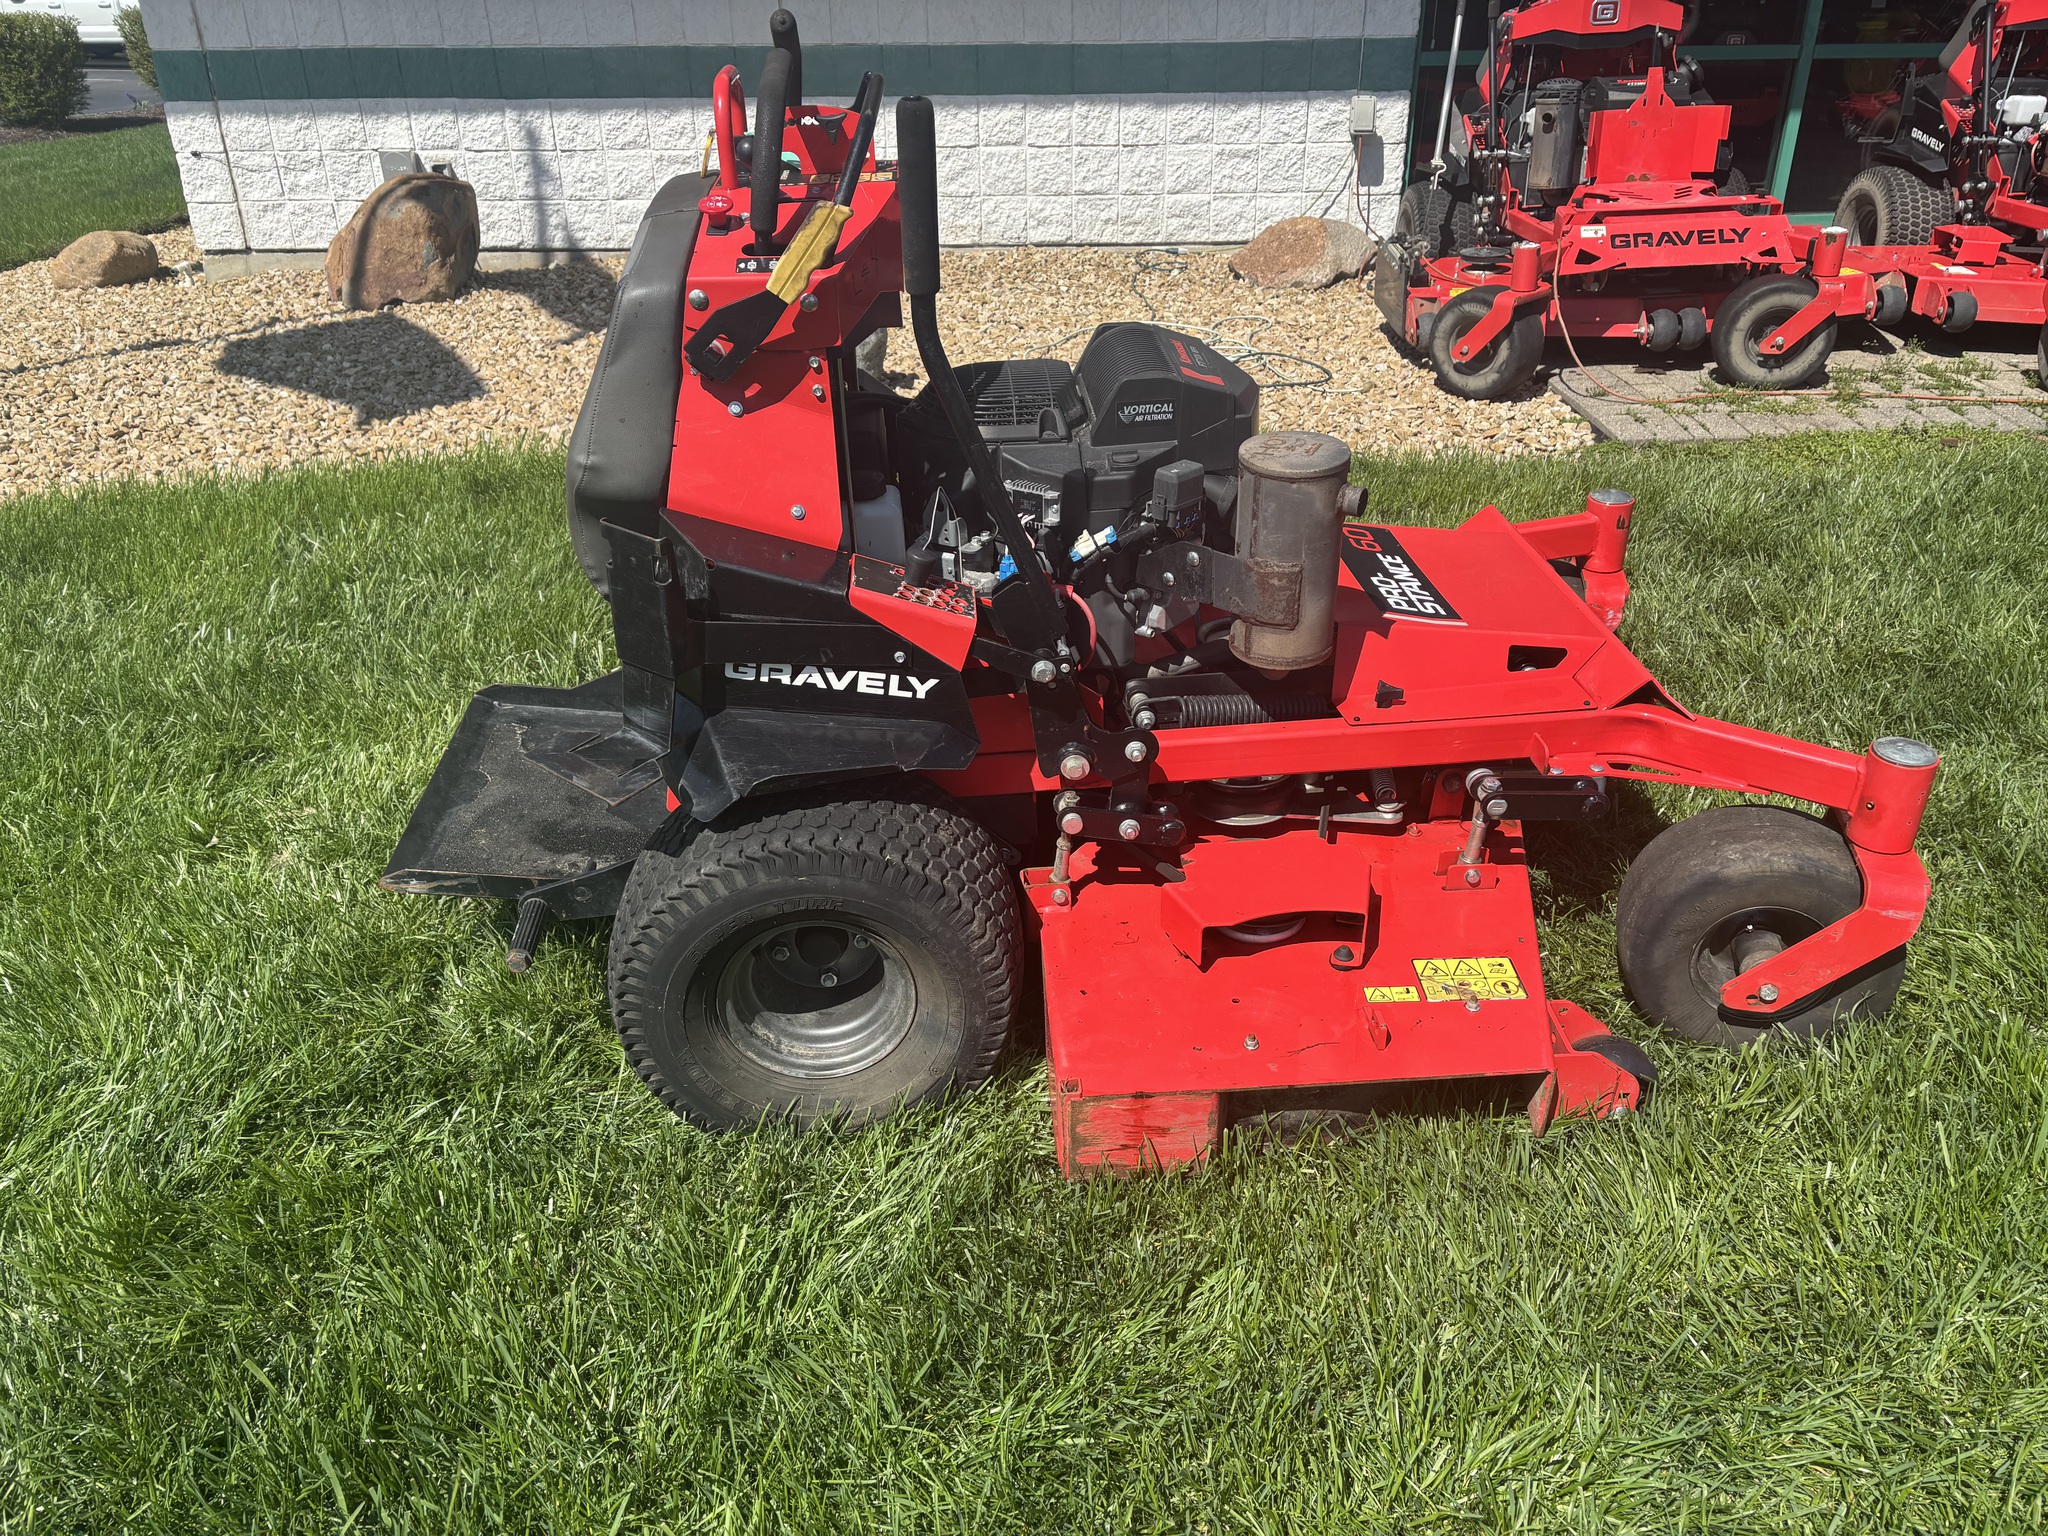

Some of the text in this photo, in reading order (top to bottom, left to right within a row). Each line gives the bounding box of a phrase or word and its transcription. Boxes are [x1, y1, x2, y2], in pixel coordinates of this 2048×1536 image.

[1596, 4, 1615, 20] G
[1910, 126, 1945, 153] GRAVELY
[1609, 227, 1752, 249] GRAVELY
[1123, 402, 1174, 416] VORTICAL
[1134, 413, 1173, 422] AIR FILTRATION
[1342, 527, 1383, 552] 60
[1376, 552, 1447, 615] STANCE
[724, 662, 941, 700] GRAVELY
[773, 897, 845, 914] TURF
[687, 911, 755, 966] SUPER
